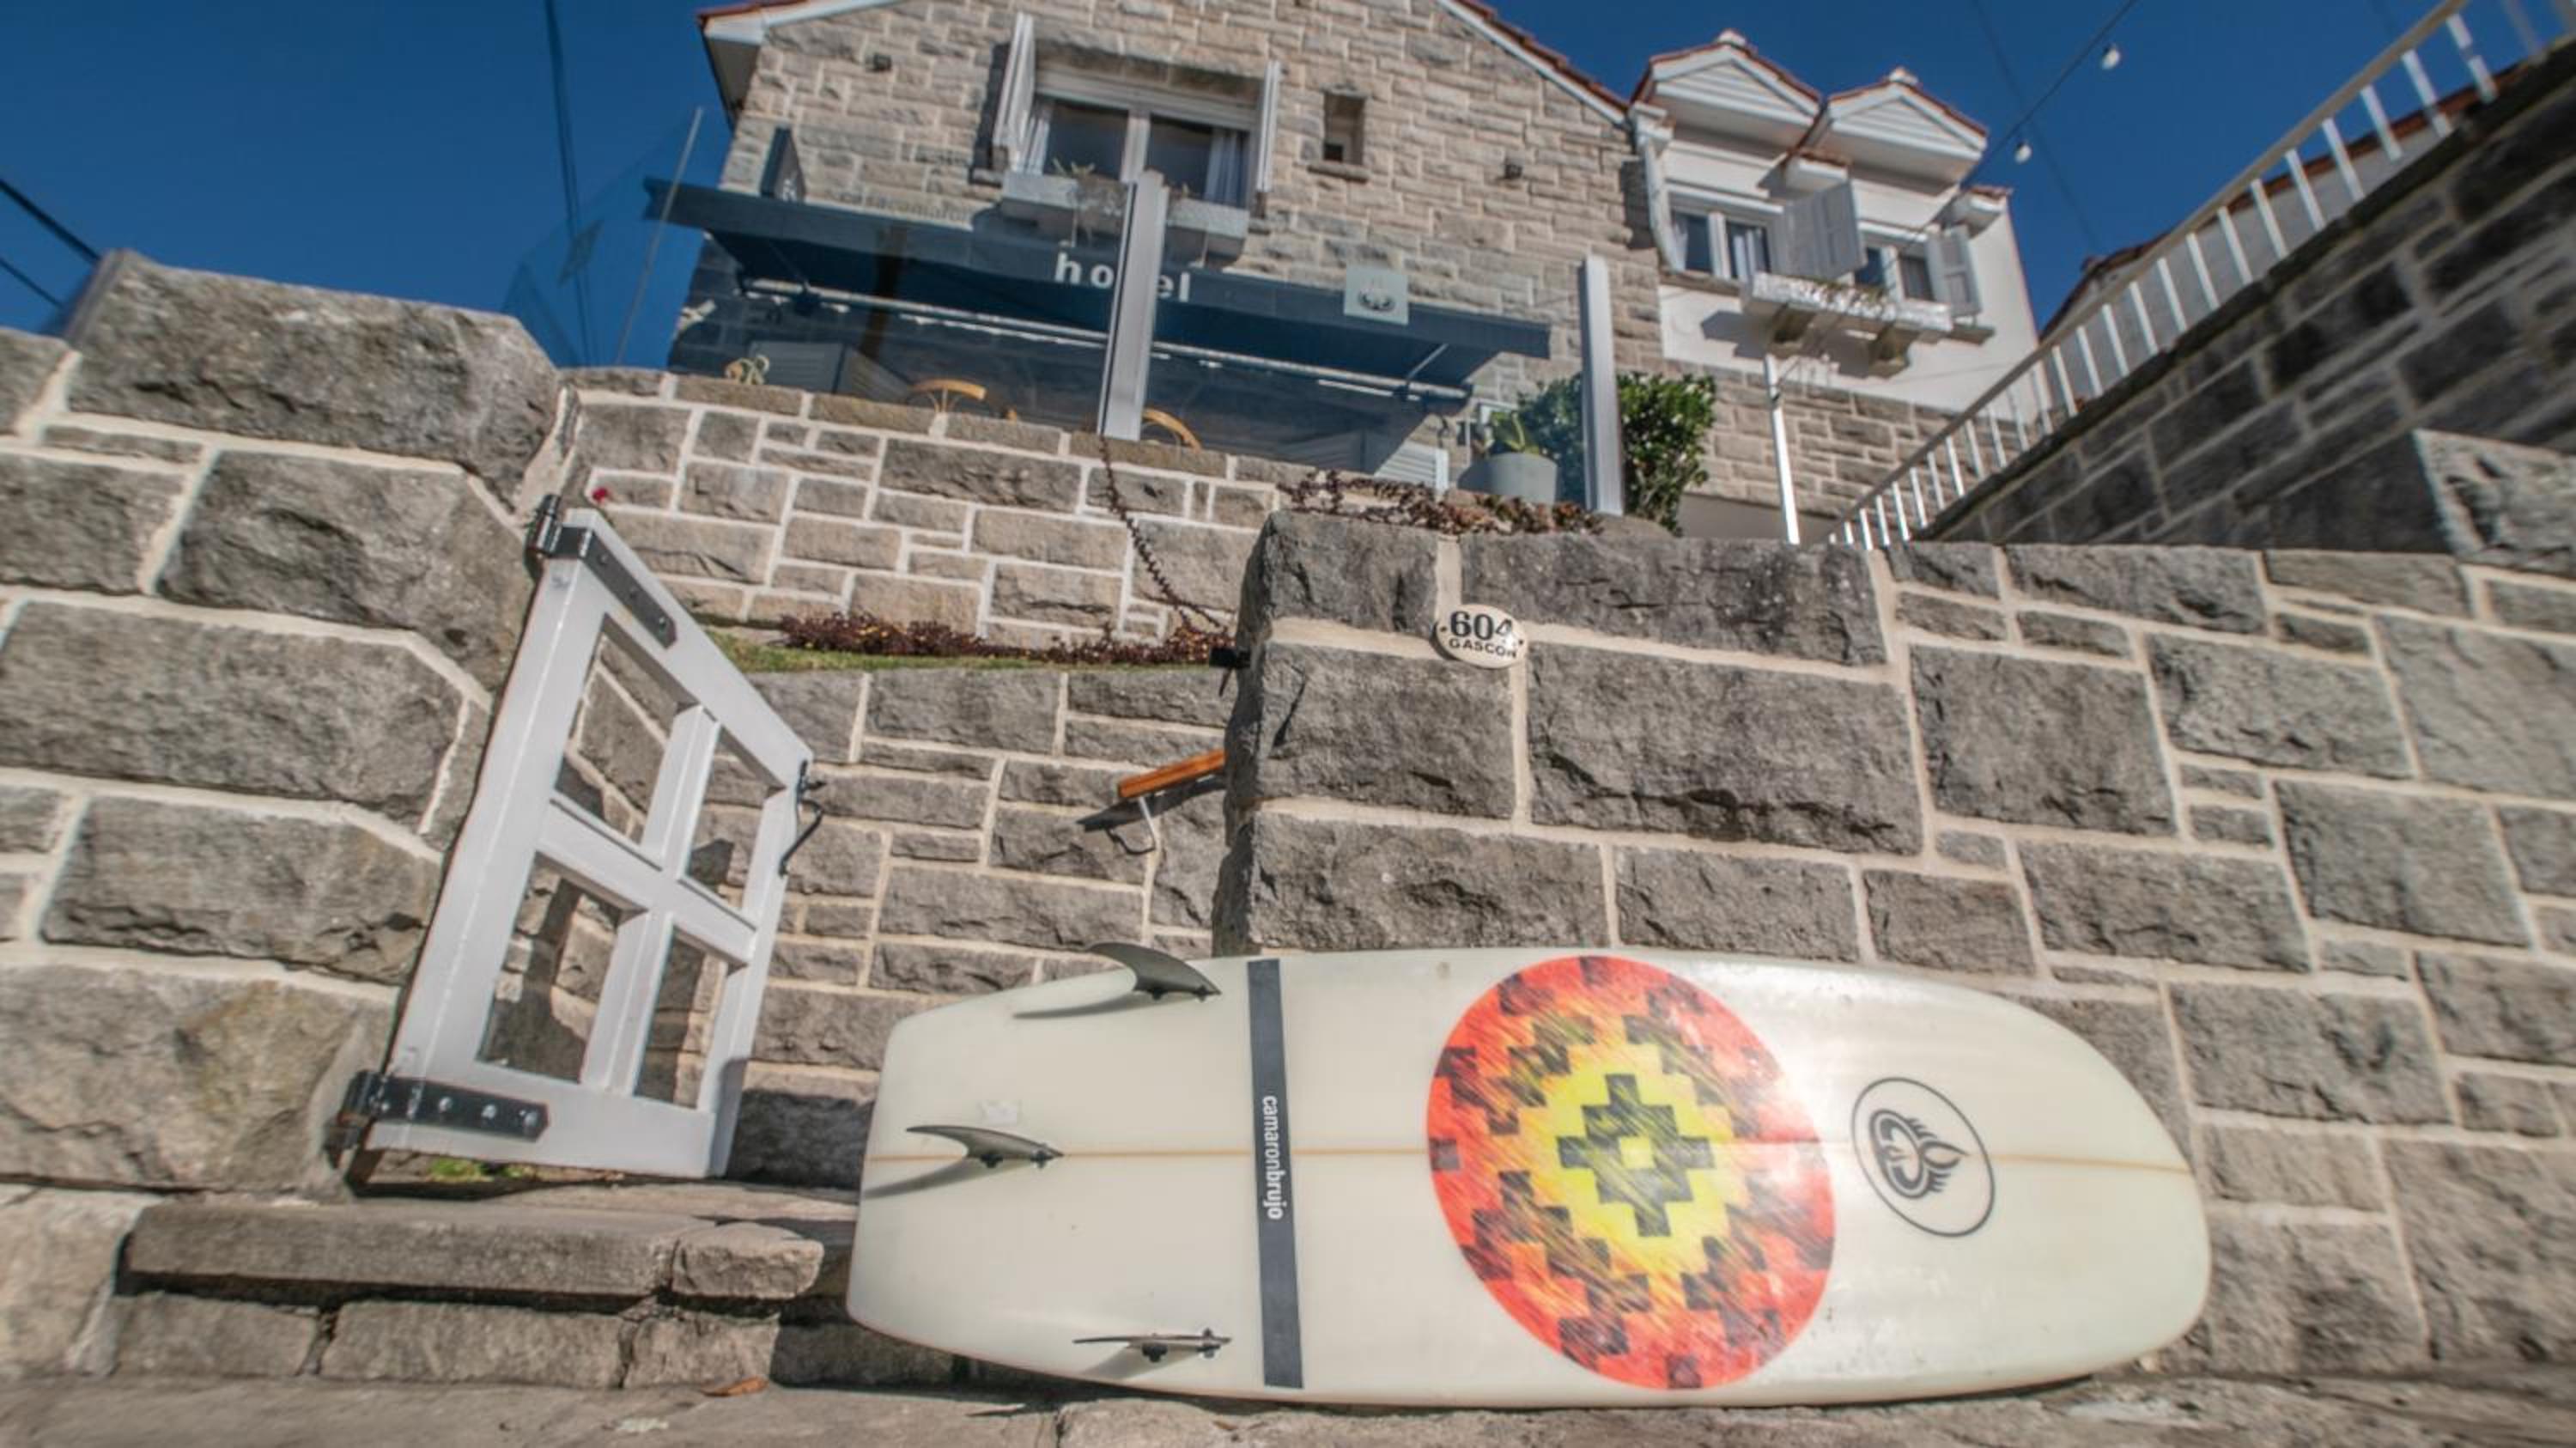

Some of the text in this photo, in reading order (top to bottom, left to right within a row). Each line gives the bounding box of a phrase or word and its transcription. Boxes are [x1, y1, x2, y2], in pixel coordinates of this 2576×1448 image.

[1054, 252, 1191, 302] hoel
[1449, 611, 1513, 641] 604
[1262, 1095, 1287, 1220] camaronbrujo
